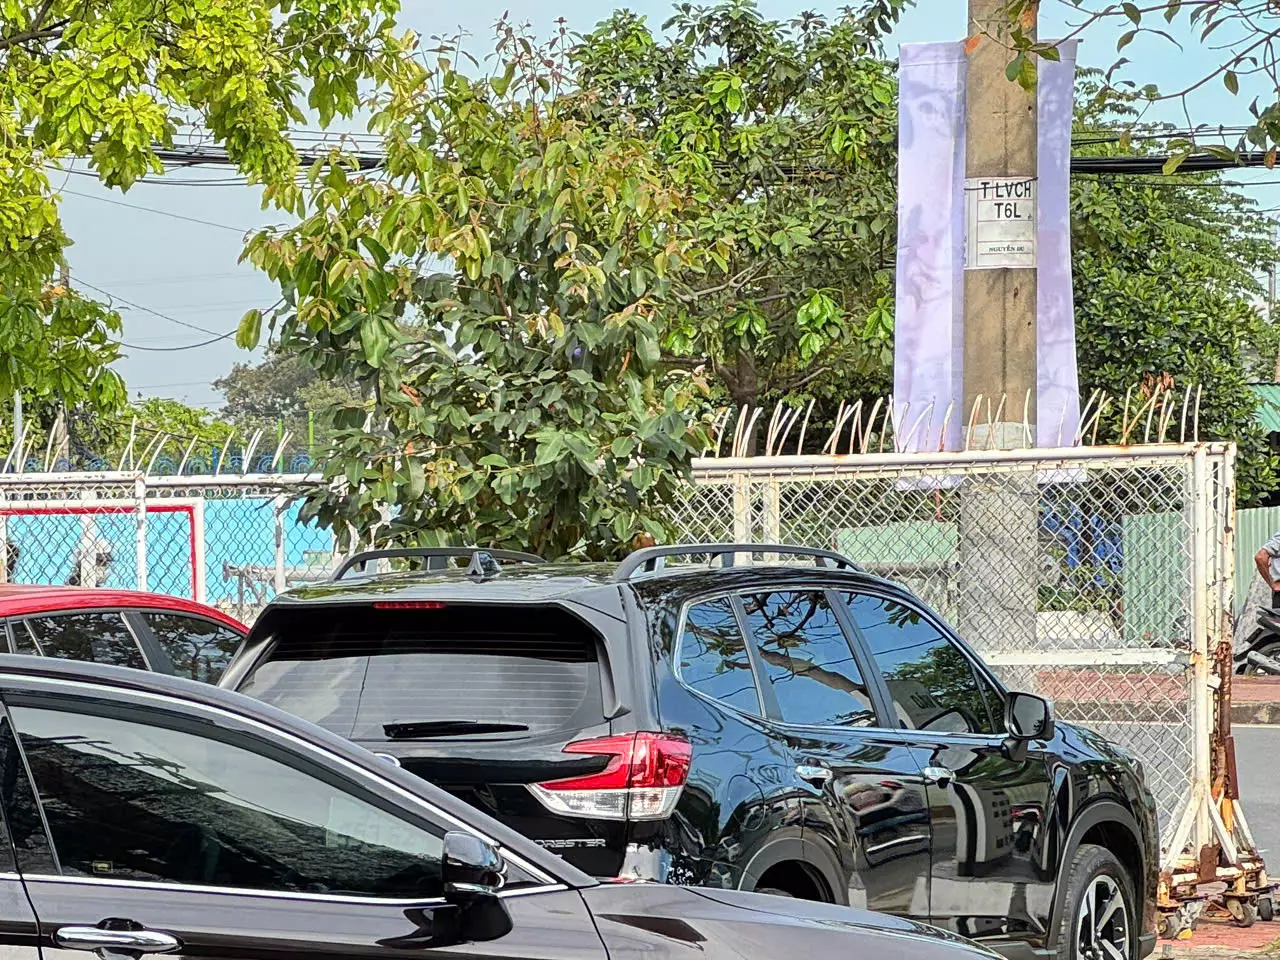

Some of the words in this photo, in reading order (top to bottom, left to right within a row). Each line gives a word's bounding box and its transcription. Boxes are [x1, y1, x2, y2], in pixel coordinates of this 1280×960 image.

[981, 182, 990, 199] T
[995, 181, 1031, 199] LVCH
[994, 202, 1022, 219] T6L
[533, 838, 606, 848] ORESTER
